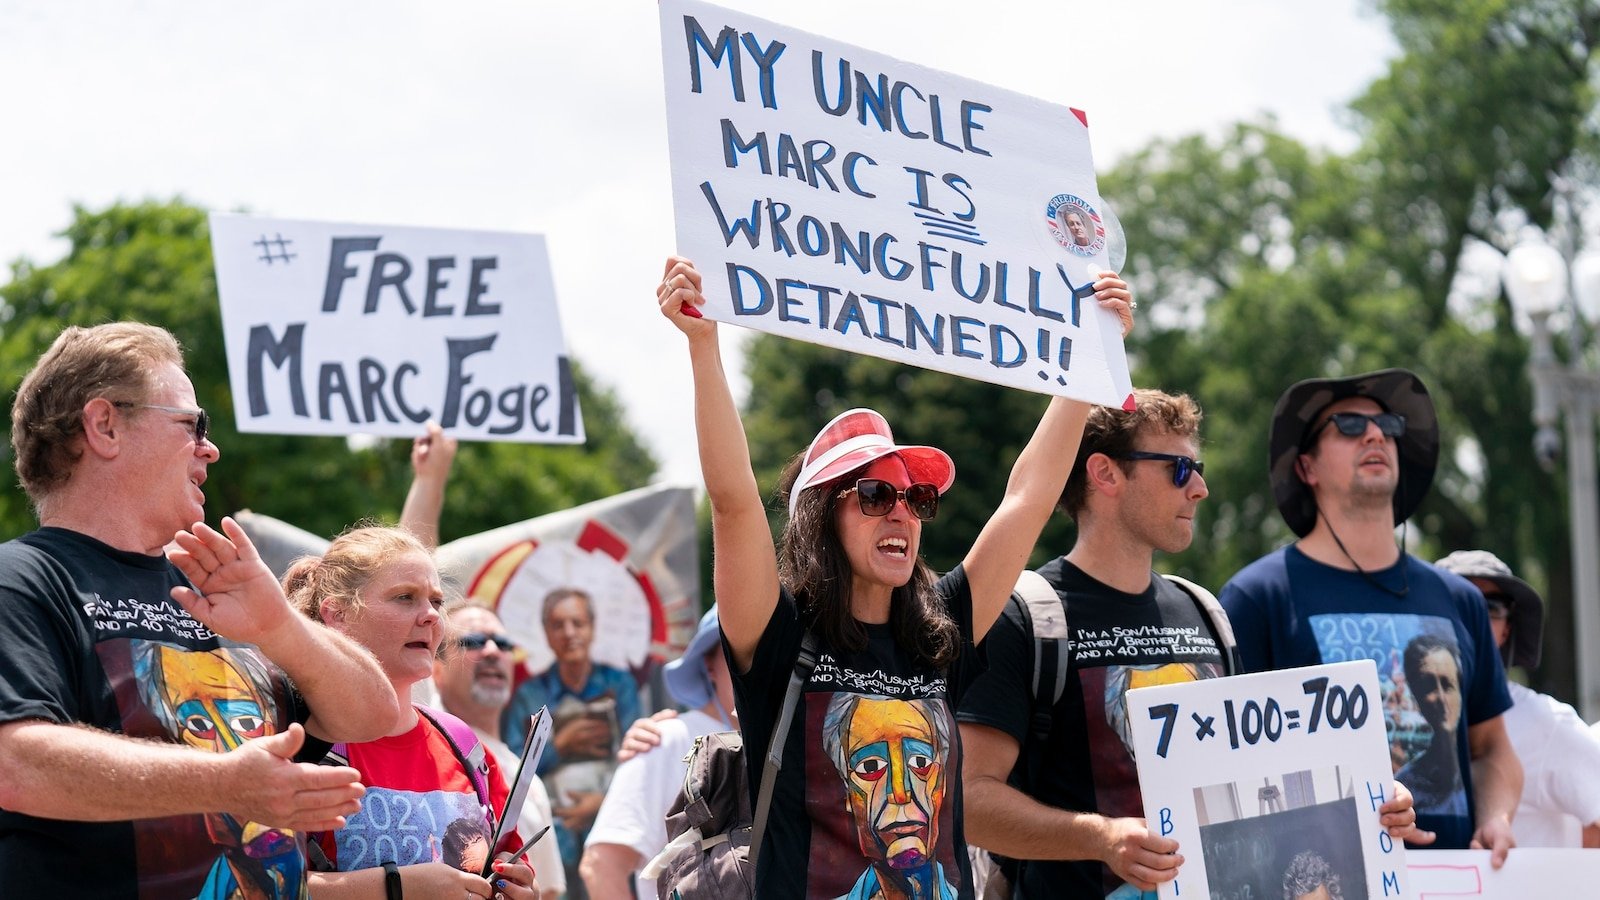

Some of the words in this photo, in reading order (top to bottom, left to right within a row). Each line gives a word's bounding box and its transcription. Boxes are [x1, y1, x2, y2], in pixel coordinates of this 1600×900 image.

[683, 15, 787, 110] MY
[811, 50, 993, 157] UNCLE
[720, 118, 878, 198] MARC
[903, 166, 976, 221] IS
[1050, 194, 1092, 213] FREEDOM
[321, 236, 503, 318] FREE
[700, 181, 1096, 327] WRONGFULLY
[726, 262, 1073, 387] DETAINED!!
[247, 322, 432, 424] MARC
[140, 618, 163, 632] 40
[1075, 649, 1101, 660] AND
[1104, 649, 1115, 657] A
[1117, 645, 1139, 656] 40
[1141, 646, 1170, 656] YEAR
[1100, 630, 1111, 638] A
[1319, 616, 1399, 648] 2021
[1149, 703, 1179, 758] 7
